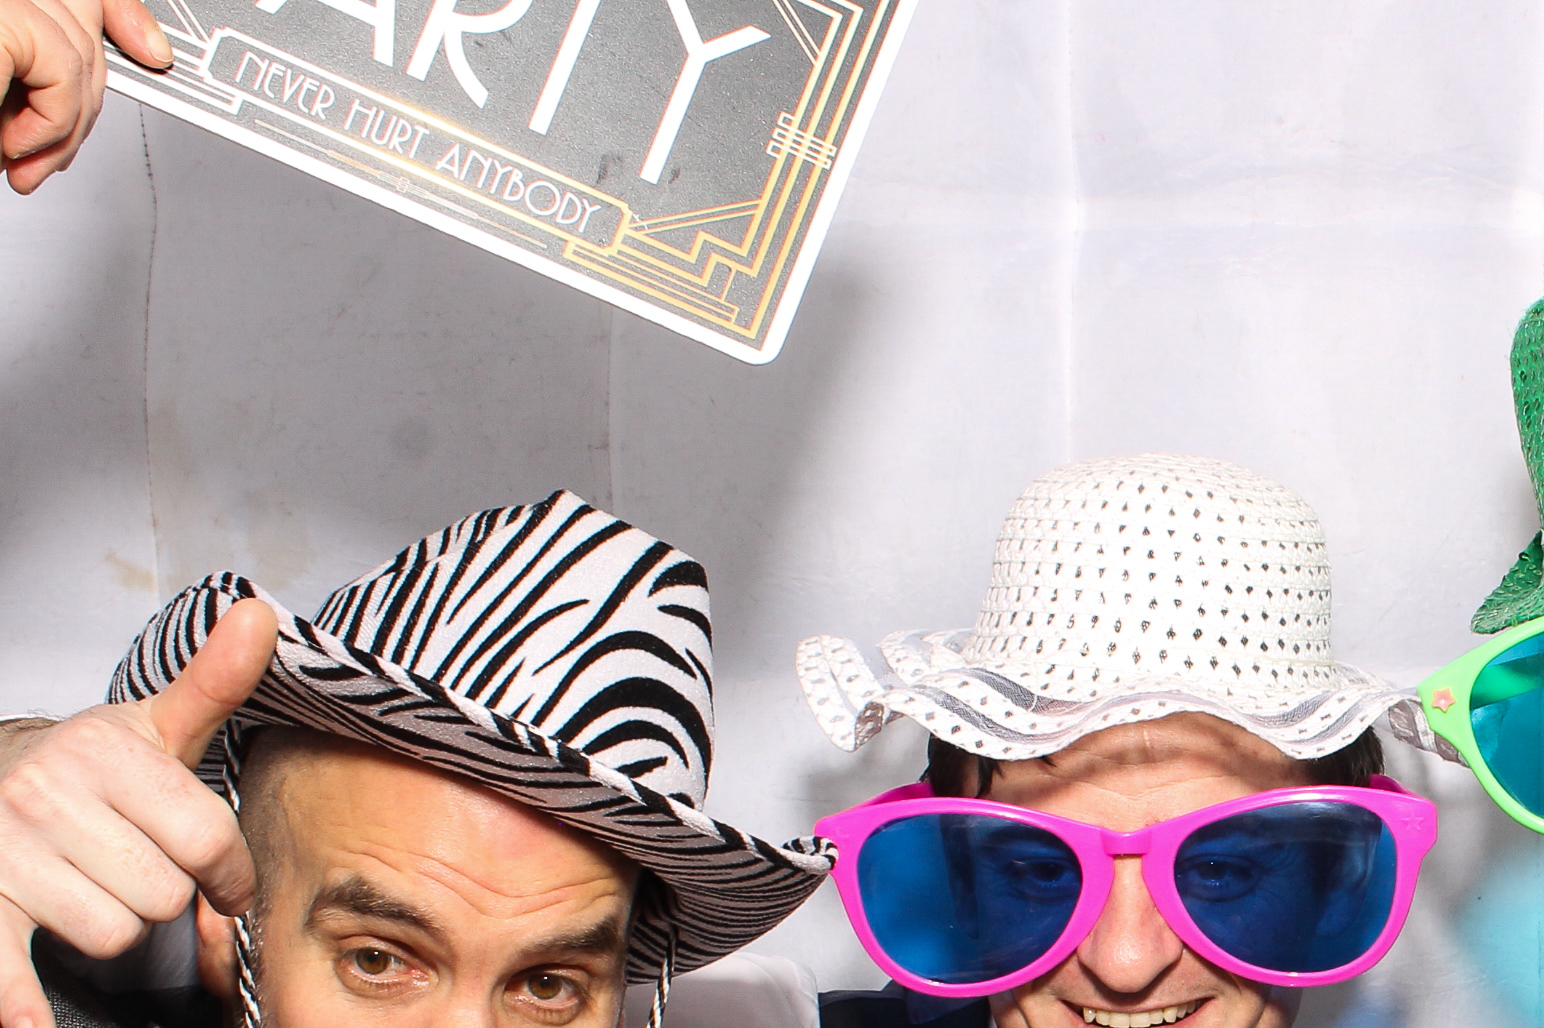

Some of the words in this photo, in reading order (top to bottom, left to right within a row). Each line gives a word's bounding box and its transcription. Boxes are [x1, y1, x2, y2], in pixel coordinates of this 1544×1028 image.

[234, 50, 336, 121] NEVER
[343, 98, 431, 159] HURT
[435, 142, 601, 233] ANYBODY
